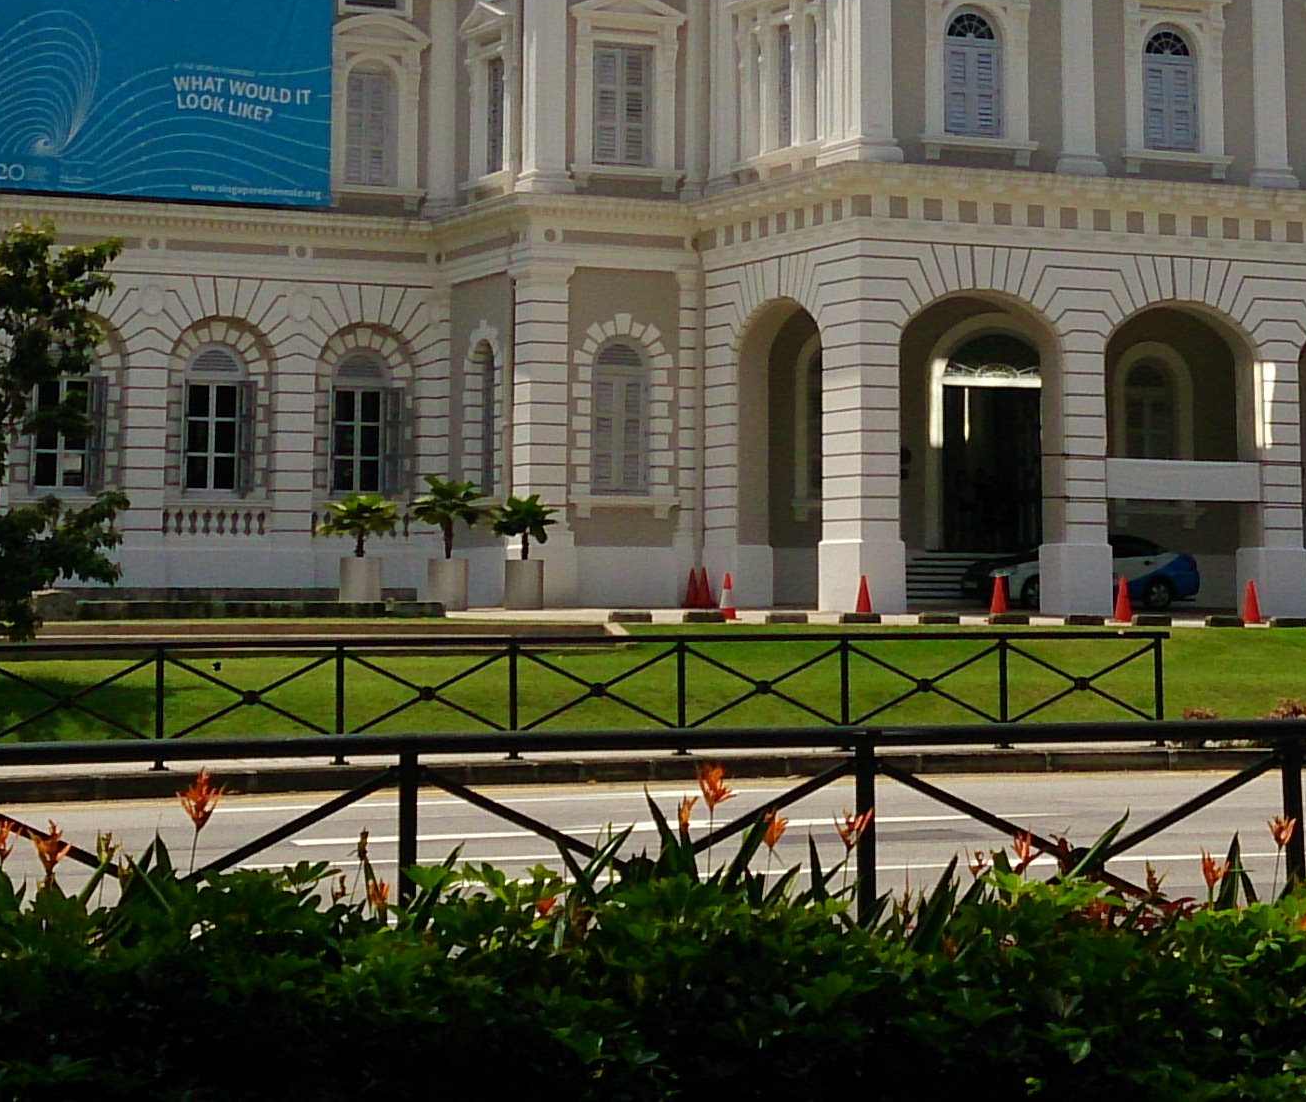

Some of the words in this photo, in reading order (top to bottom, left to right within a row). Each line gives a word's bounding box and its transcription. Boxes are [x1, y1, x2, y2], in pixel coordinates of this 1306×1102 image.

[173, 76, 225, 93] WHAT
[229, 79, 291, 104] WOULD
[296, 89, 311, 105] IT
[177, 93, 225, 112] LOOK
[228, 99, 273, 122] LIKE?
